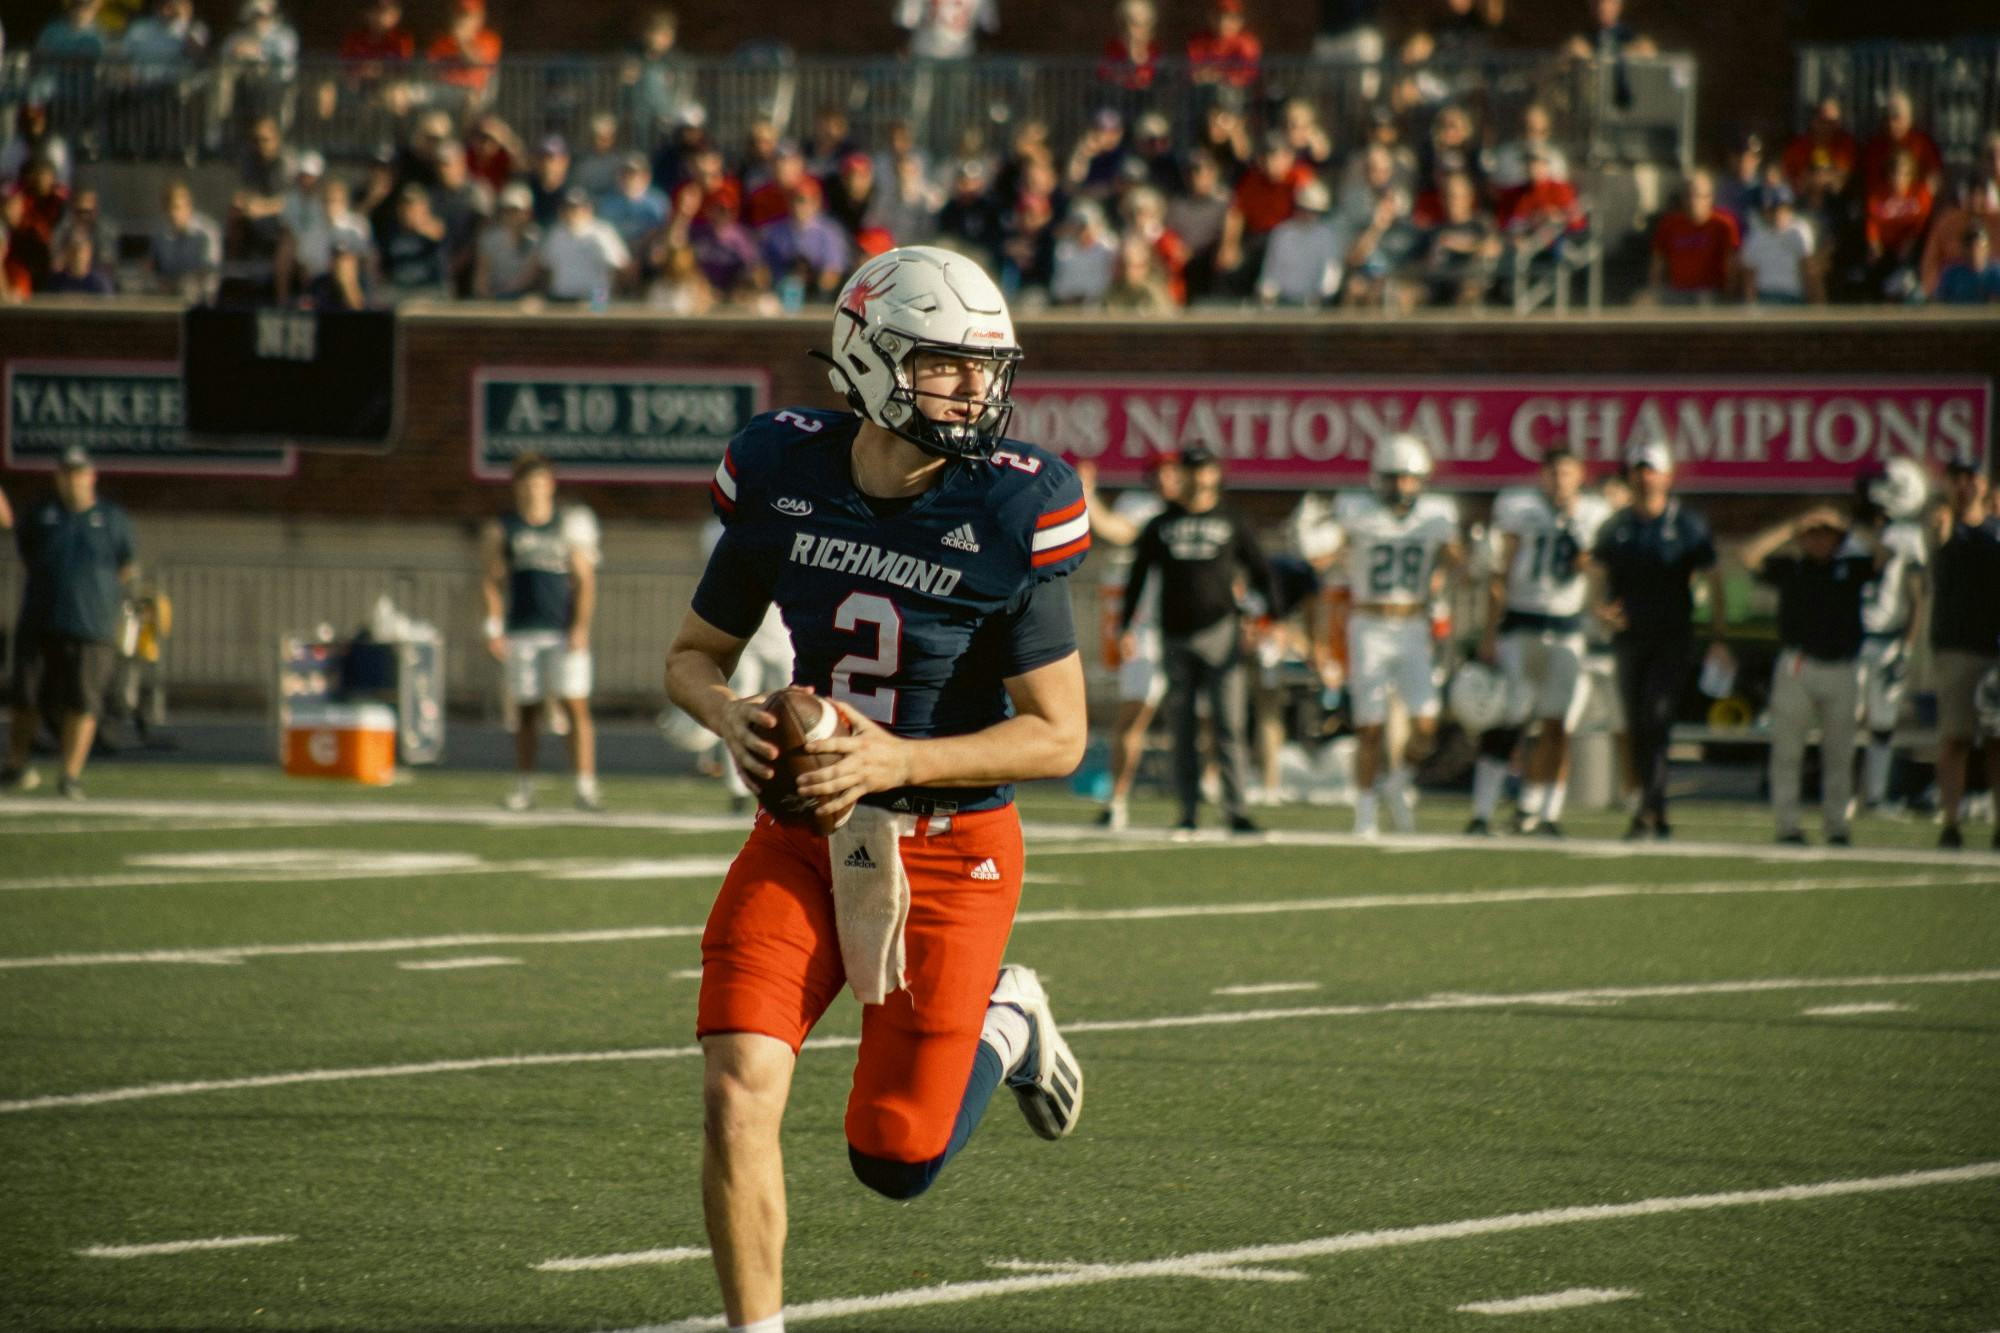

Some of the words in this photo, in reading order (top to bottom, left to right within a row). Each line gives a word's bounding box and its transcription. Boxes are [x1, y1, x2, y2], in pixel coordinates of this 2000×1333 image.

[14, 383, 185, 426] YANKEE
[507, 387, 617, 432] A-10
[1122, 397, 1499, 462] NATIONAL
[1509, 396, 1975, 464] CHAMPIONS
[776, 497, 808, 513] CAA
[789, 532, 962, 597] RICHMOND
[940, 534, 980, 553] adidas
[831, 590, 902, 726] 2
[844, 859, 876, 869] adidas
[970, 870, 1000, 880] adidas
